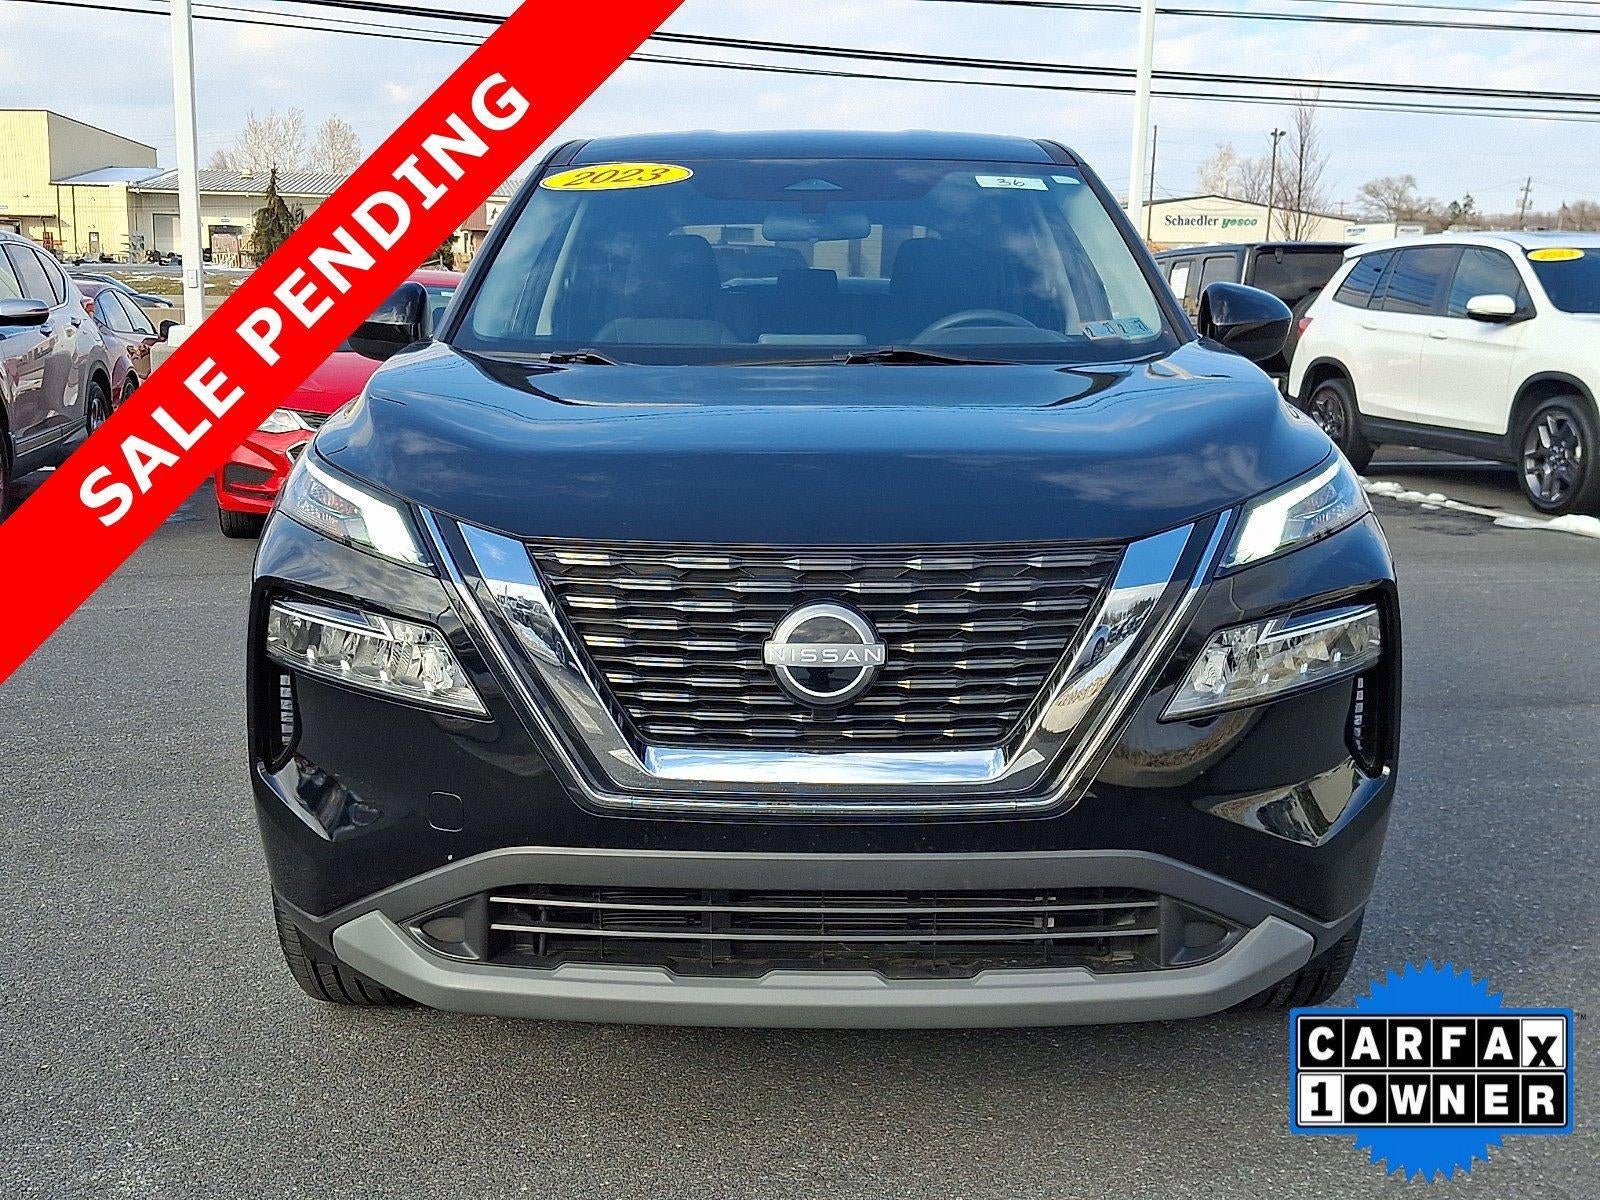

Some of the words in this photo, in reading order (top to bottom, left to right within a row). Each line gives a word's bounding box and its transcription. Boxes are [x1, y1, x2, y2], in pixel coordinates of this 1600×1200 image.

[562, 167, 671, 187] 2023
[1164, 214, 1220, 226] Schaedler
[768, 648, 881, 663] NISSAN
